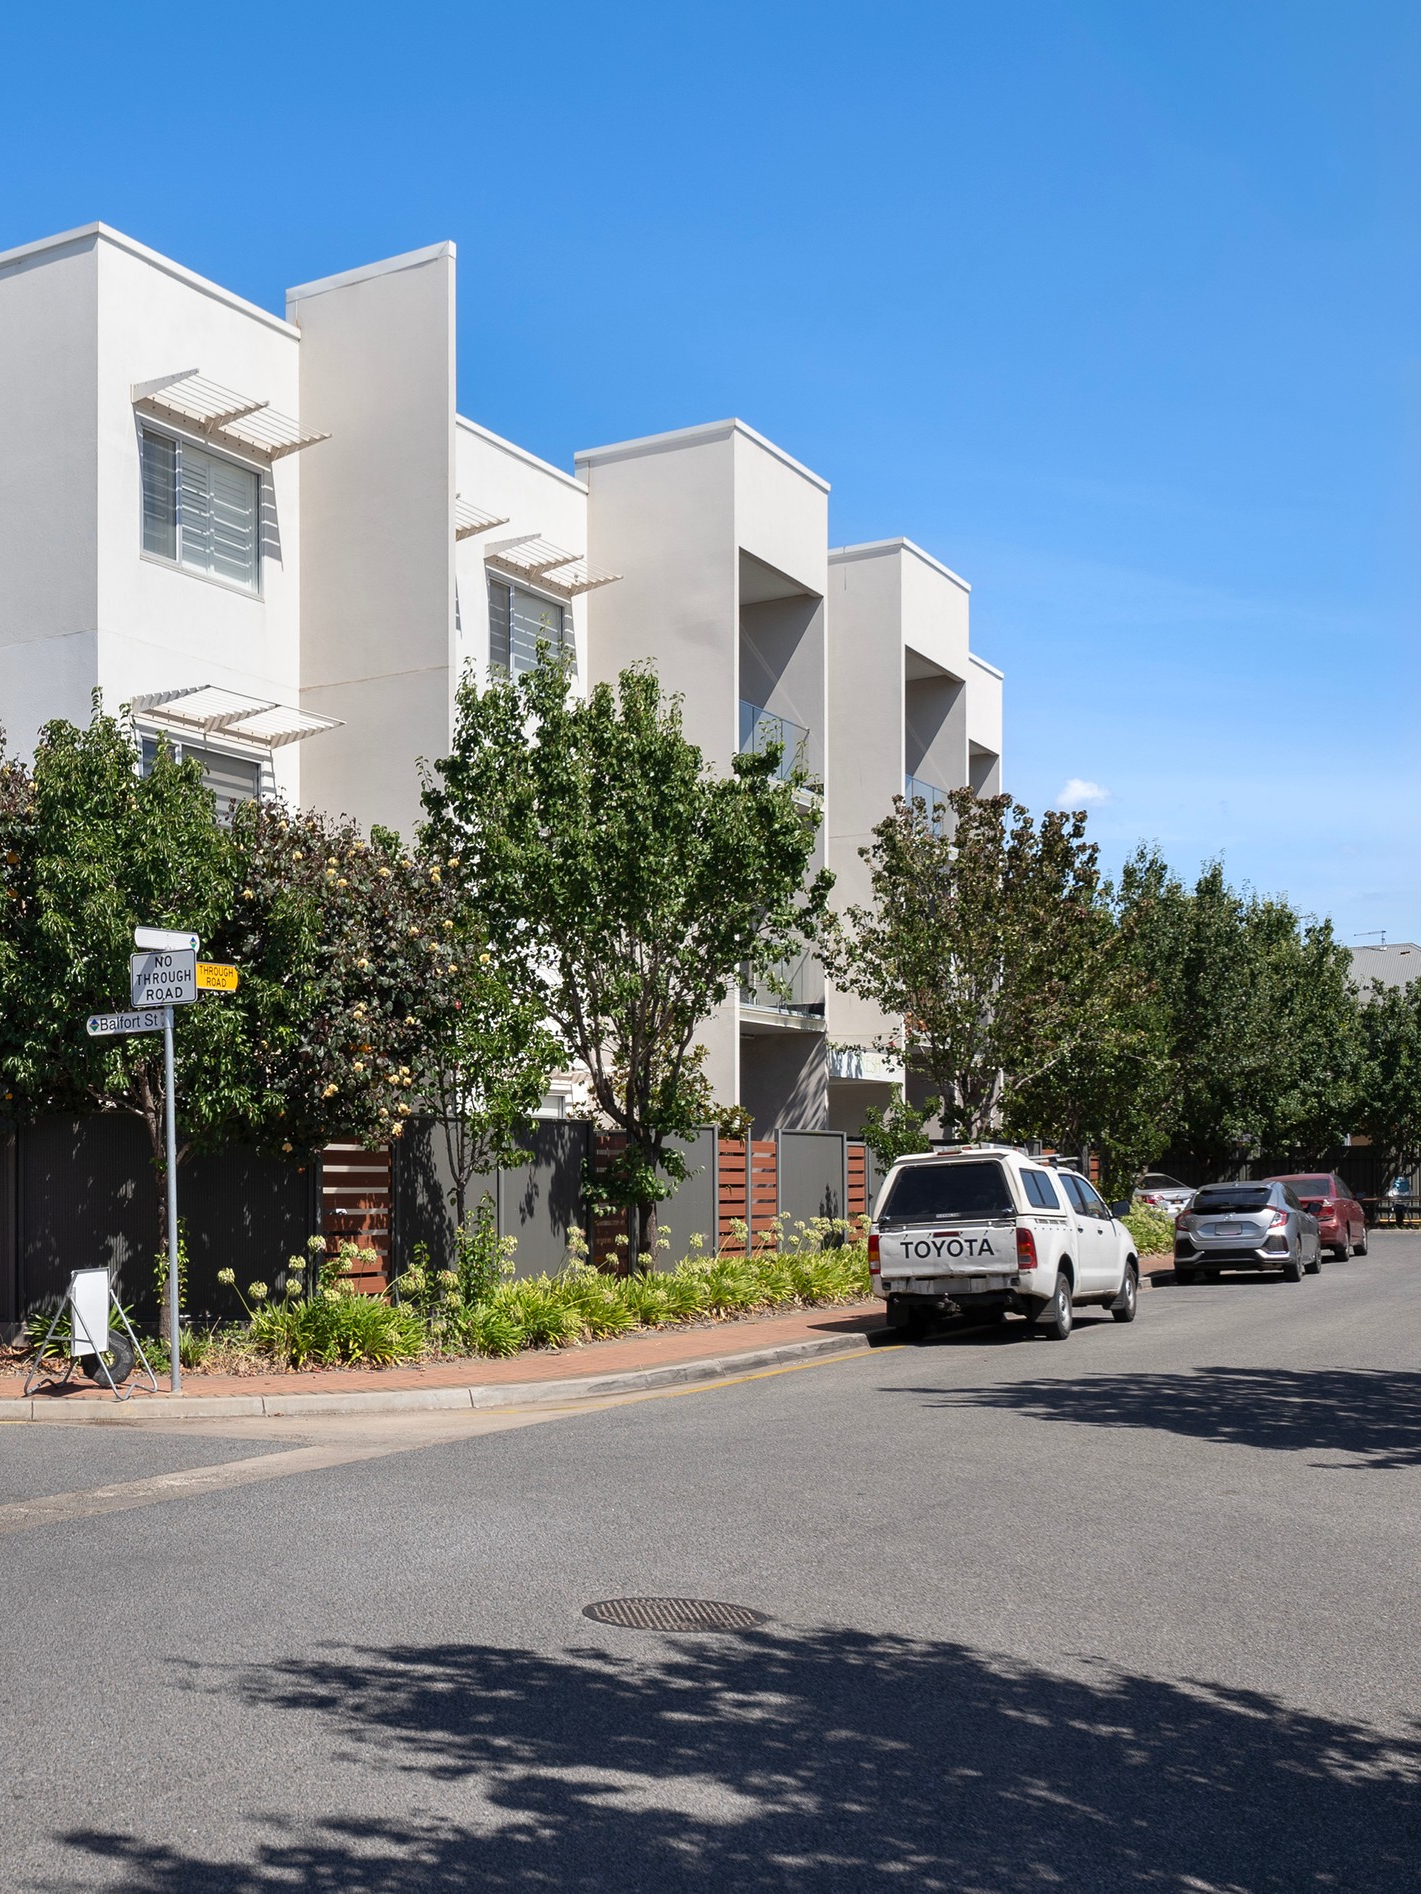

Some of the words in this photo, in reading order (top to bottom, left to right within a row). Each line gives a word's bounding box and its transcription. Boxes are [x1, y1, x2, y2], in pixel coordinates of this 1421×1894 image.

[155, 955, 172, 968] NO
[136, 969, 191, 986] THROUGH
[199, 965, 234, 978] THROUGH
[206, 976, 227, 988] ROAD
[146, 986, 183, 1001] ROAD
[100, 1015, 141, 1031] Balfort
[144, 1012, 158, 1027] St
[900, 1238, 995, 1259] TOYOTA
